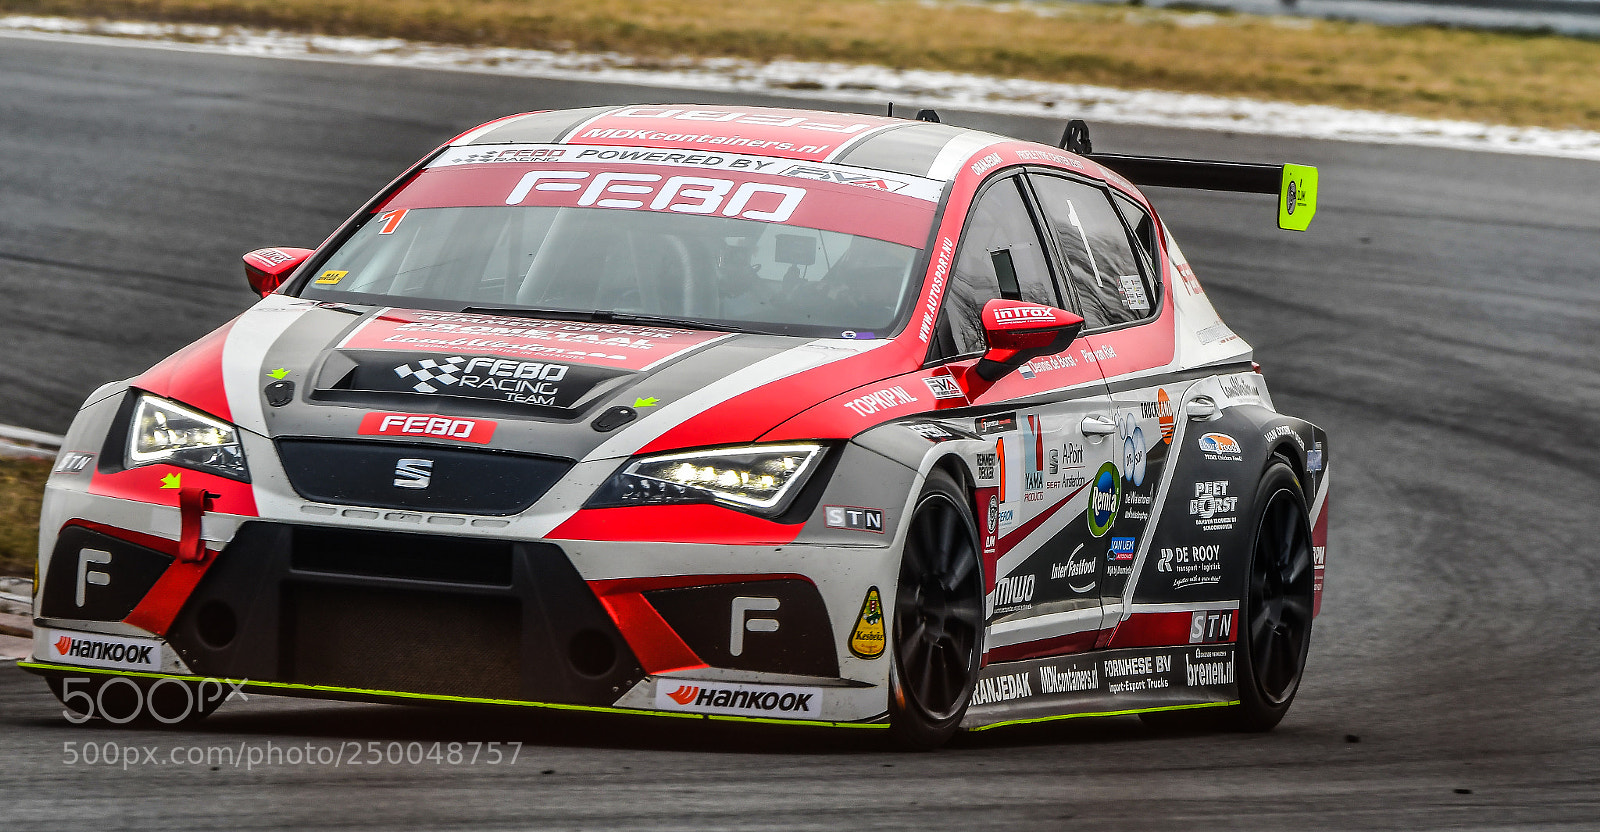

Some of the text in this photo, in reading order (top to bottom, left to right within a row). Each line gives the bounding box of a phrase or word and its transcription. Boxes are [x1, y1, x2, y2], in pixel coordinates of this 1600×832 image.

[499, 149, 567, 157] FEBO
[581, 128, 830, 155] MDKcontainers.nl
[576, 148, 774, 172] POWERED BY
[505, 170, 807, 223] FEBO
[378, 209, 411, 235] 1
[918, 237, 954, 343] WWW.AUTOSPORT.NU
[398, 322, 657, 347] PROMETAAL
[463, 357, 569, 380] FEBO
[1028, 357, 1053, 374] Dennis
[458, 375, 559, 396] RACING
[505, 392, 556, 406] TEAM
[844, 386, 918, 417] TOPKIP.NL
[379, 415, 476, 438] FEBO
[996, 437, 1006, 503] 1
[1025, 472, 1043, 490] YAMA
[1046, 481, 1061, 489] SEAT
[1195, 480, 1229, 497] PEET
[1091, 487, 1117, 516] Remia
[828, 509, 881, 528] STN
[1175, 544, 1220, 563] DE ROOY
[75, 548, 112, 608] F
[1051, 562, 1068, 579] Inter
[1068, 557, 1096, 578] Fastfood
[730, 596, 781, 657] F
[1191, 613, 1232, 639] STN
[1039, 662, 1099, 694] MDKcontainers.nl
[1104, 655, 1172, 678] FORNHESE BV
[1185, 650, 1235, 687] brenen.nl
[968, 671, 1033, 706] RANJEDAK
[1147, 678, 1169, 690] Trucks
